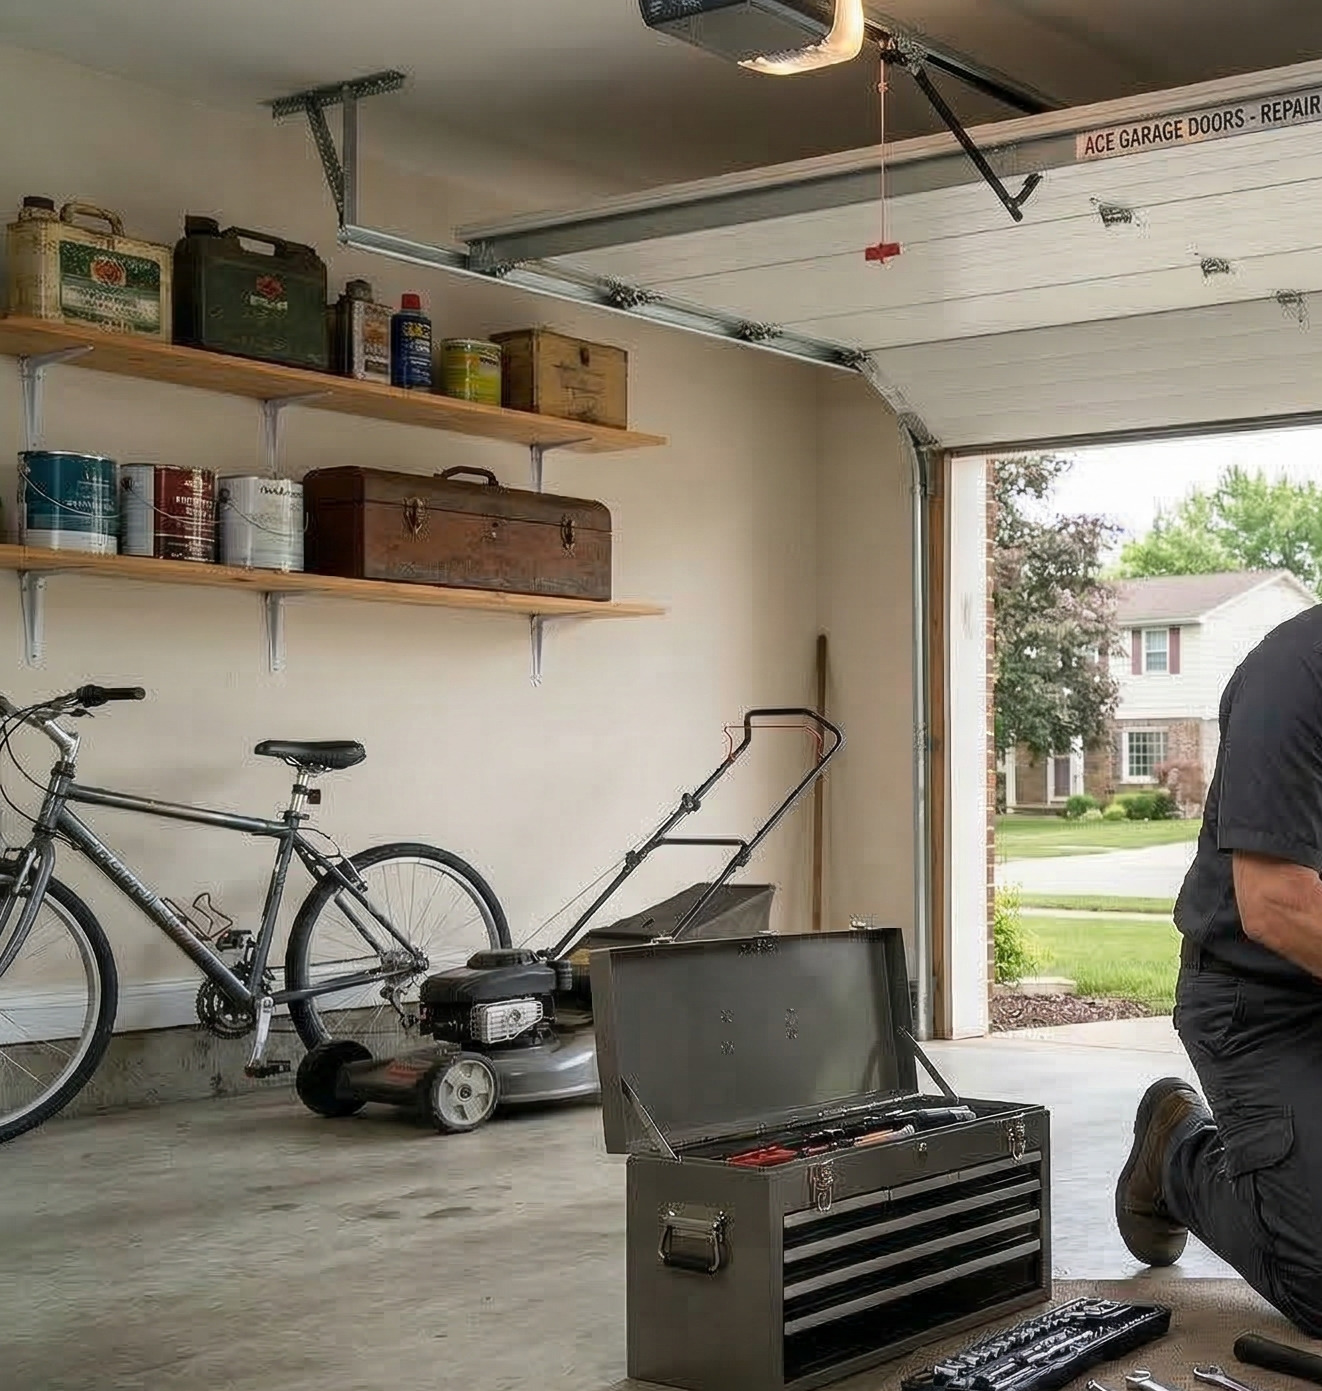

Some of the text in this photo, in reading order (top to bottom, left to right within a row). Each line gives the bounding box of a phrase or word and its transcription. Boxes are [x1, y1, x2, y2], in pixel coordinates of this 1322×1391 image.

[1084, 131, 1116, 156] ACE
[1119, 119, 1184, 149] GARAGE
[1188, 108, 1245, 137] DOORS
[1261, 96, 1321, 124] REPAIR
